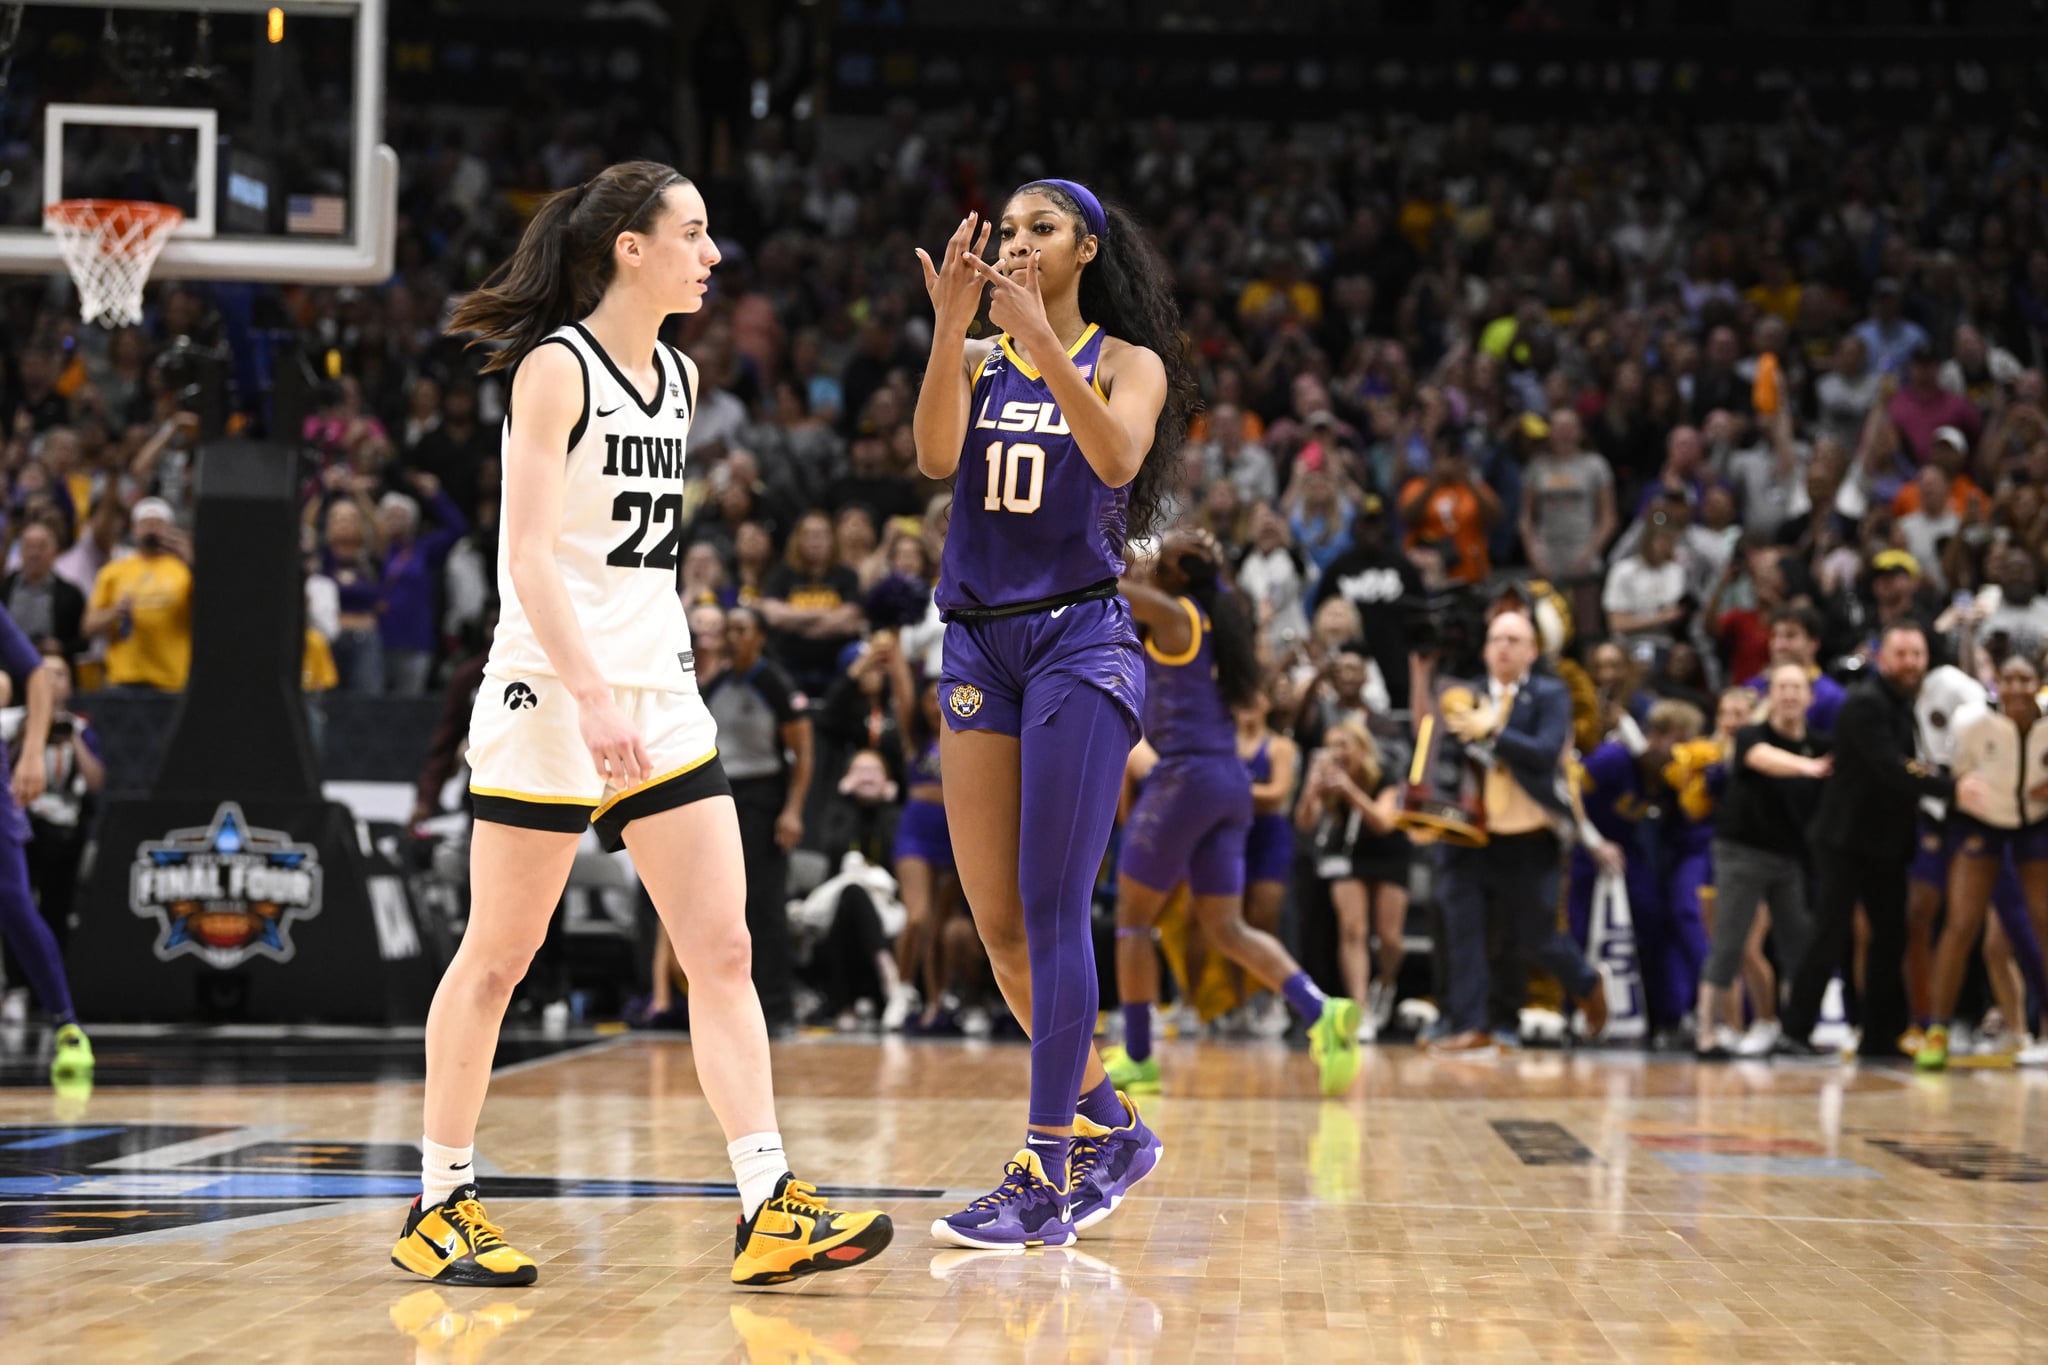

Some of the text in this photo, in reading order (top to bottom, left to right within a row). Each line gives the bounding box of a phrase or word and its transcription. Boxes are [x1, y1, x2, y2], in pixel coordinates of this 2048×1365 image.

[975, 395, 1071, 436] LSU
[984, 441, 1046, 514] 10
[606, 491, 683, 570] 22
[139, 863, 225, 905] FINAL
